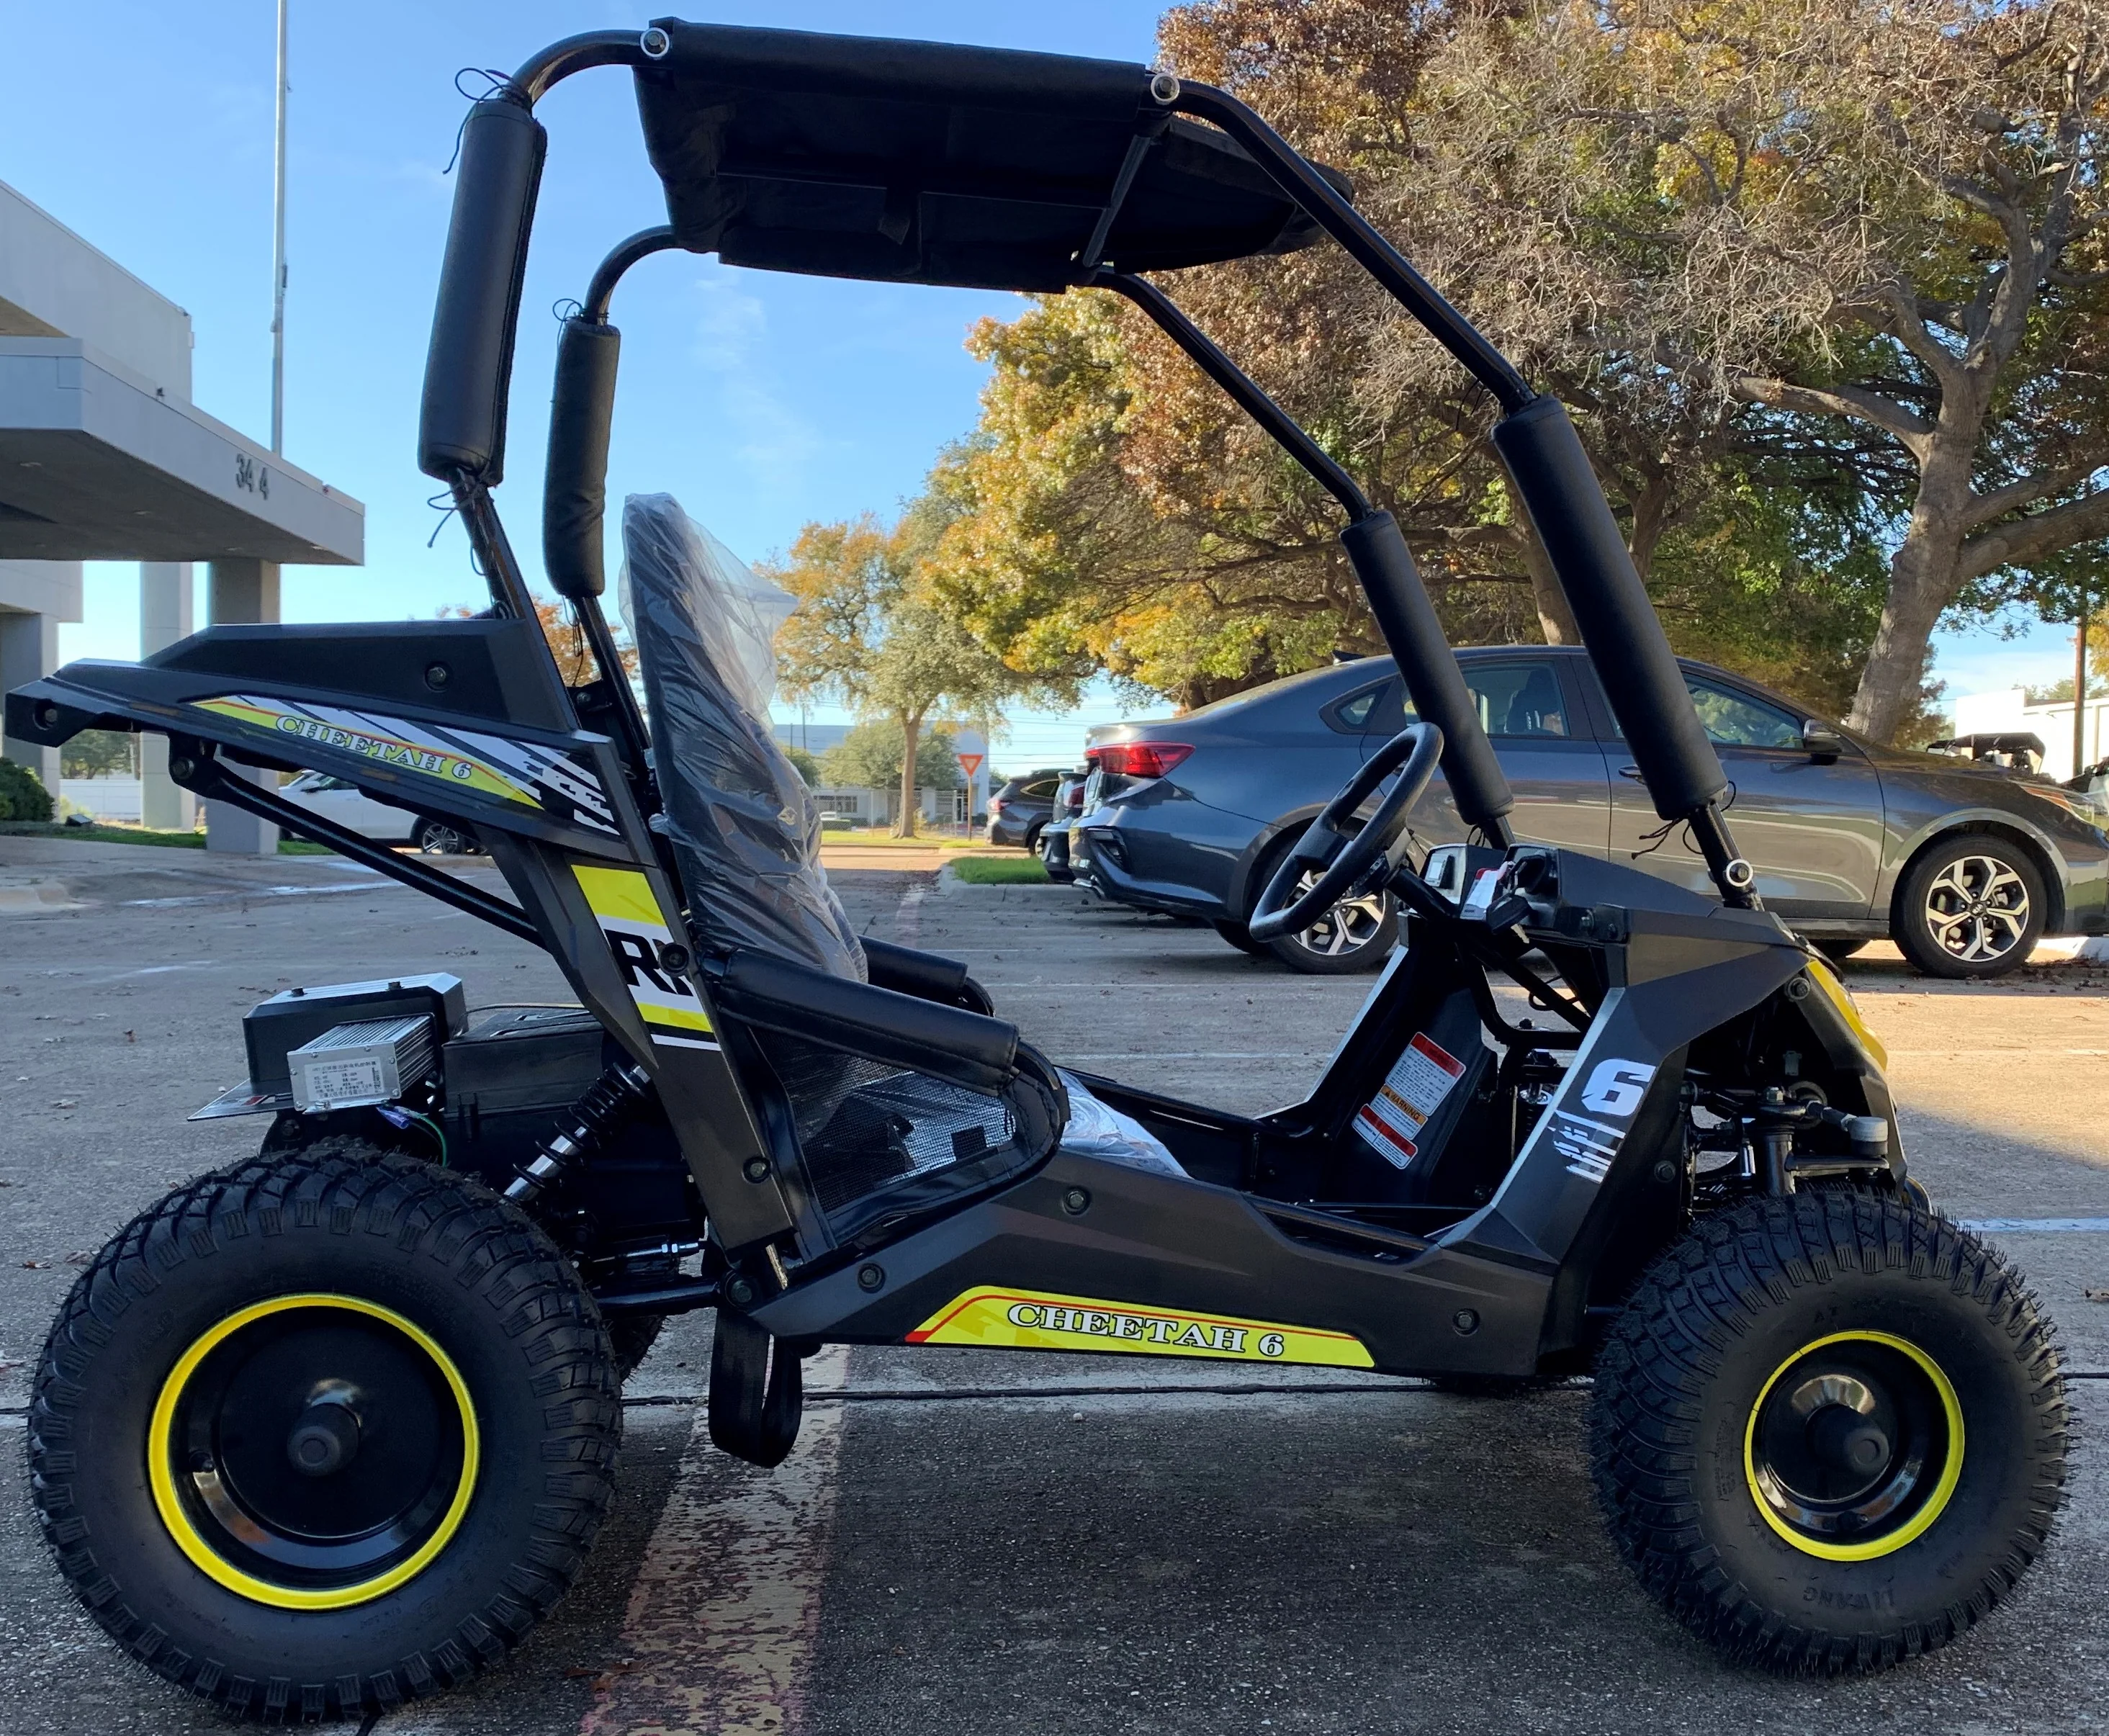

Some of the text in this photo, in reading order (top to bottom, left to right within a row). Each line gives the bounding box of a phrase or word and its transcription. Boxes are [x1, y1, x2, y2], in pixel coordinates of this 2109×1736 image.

[276, 715, 472, 780] CHEETAH 6
[1390, 1094, 1421, 1120] WARNING
[1007, 1303, 1285, 1357] CHEETAH 6
